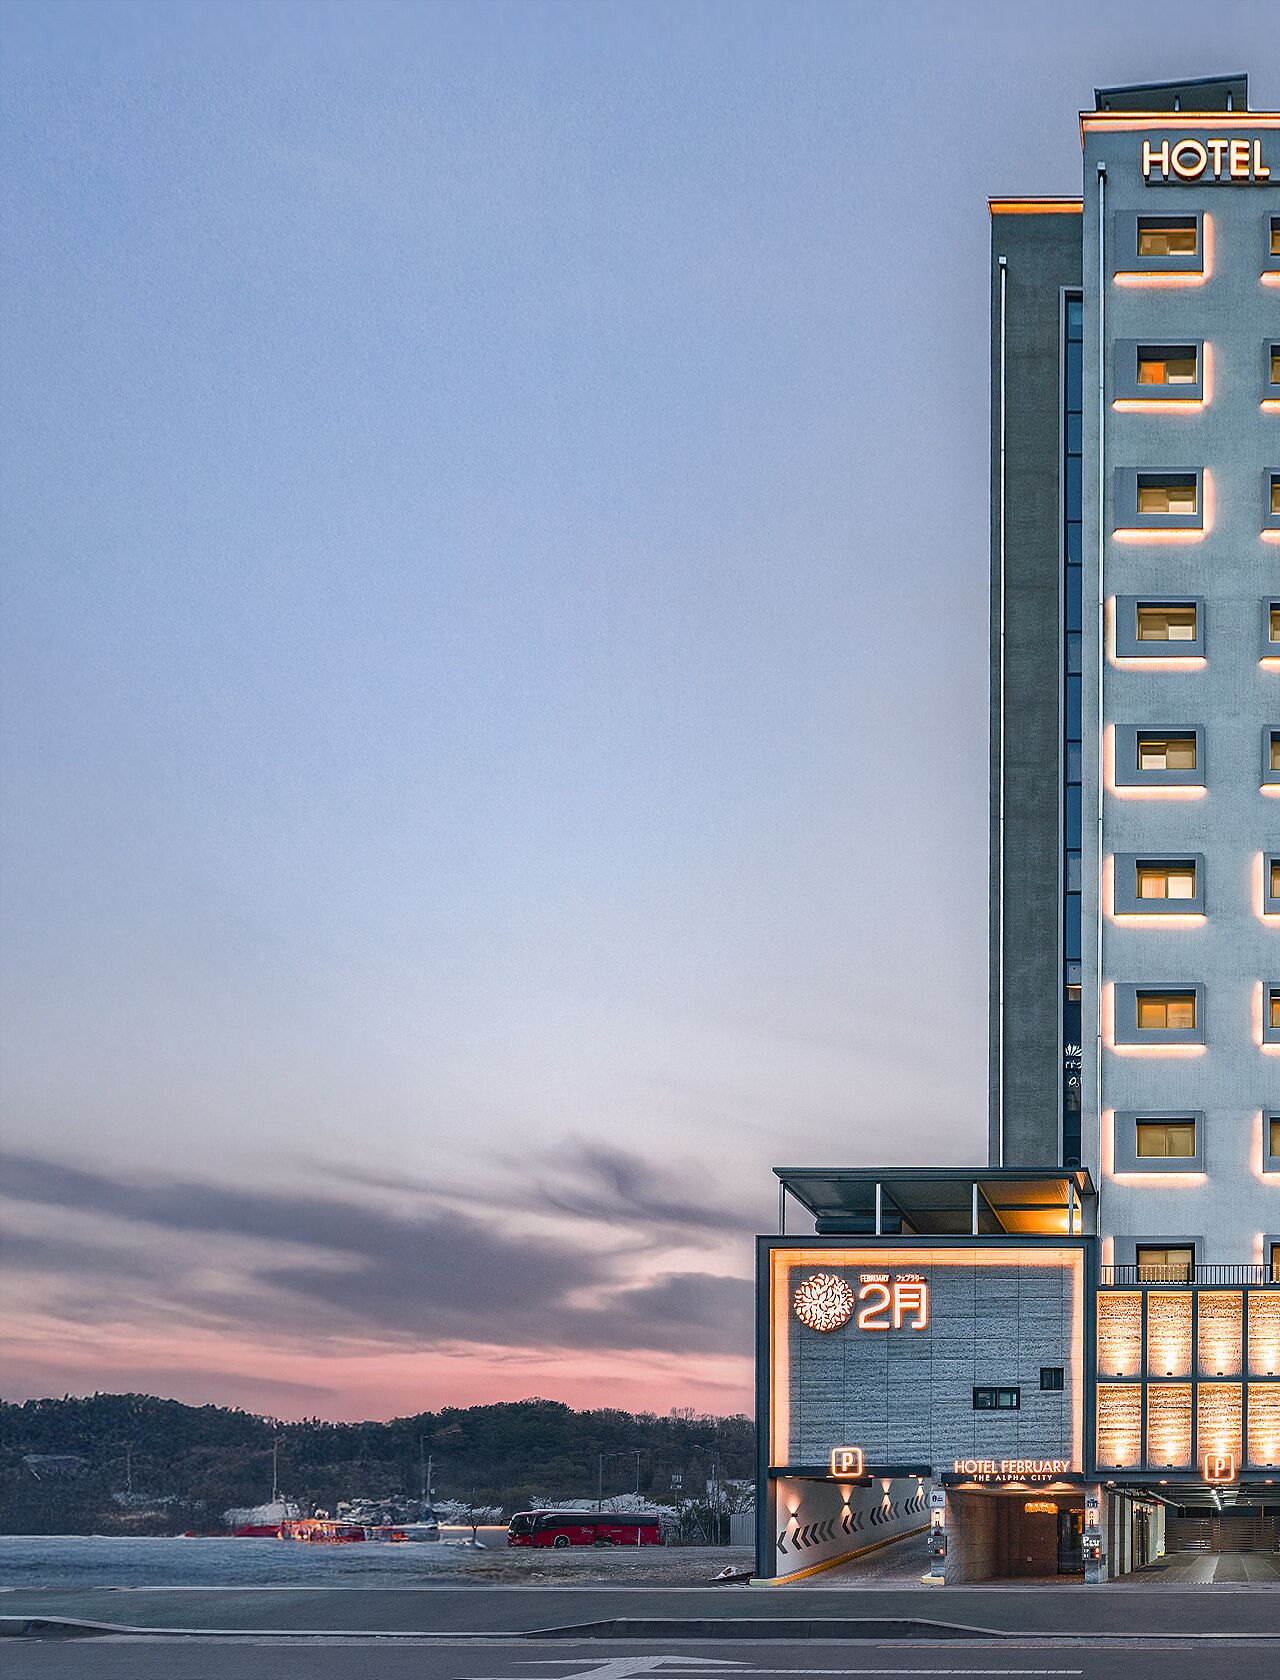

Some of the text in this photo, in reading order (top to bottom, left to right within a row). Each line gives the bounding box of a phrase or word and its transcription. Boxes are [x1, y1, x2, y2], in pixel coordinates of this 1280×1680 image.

[1142, 138, 1271, 178] HOTEL
[860, 1274, 890, 1283] FEBRUARY
[859, 1283, 927, 1329] 2月
[842, 1452, 854, 1472] P
[954, 1460, 1070, 1474] HOTEL FEBRUARY
[1215, 1457, 1226, 1478] P
[973, 1474, 990, 1482] THE
